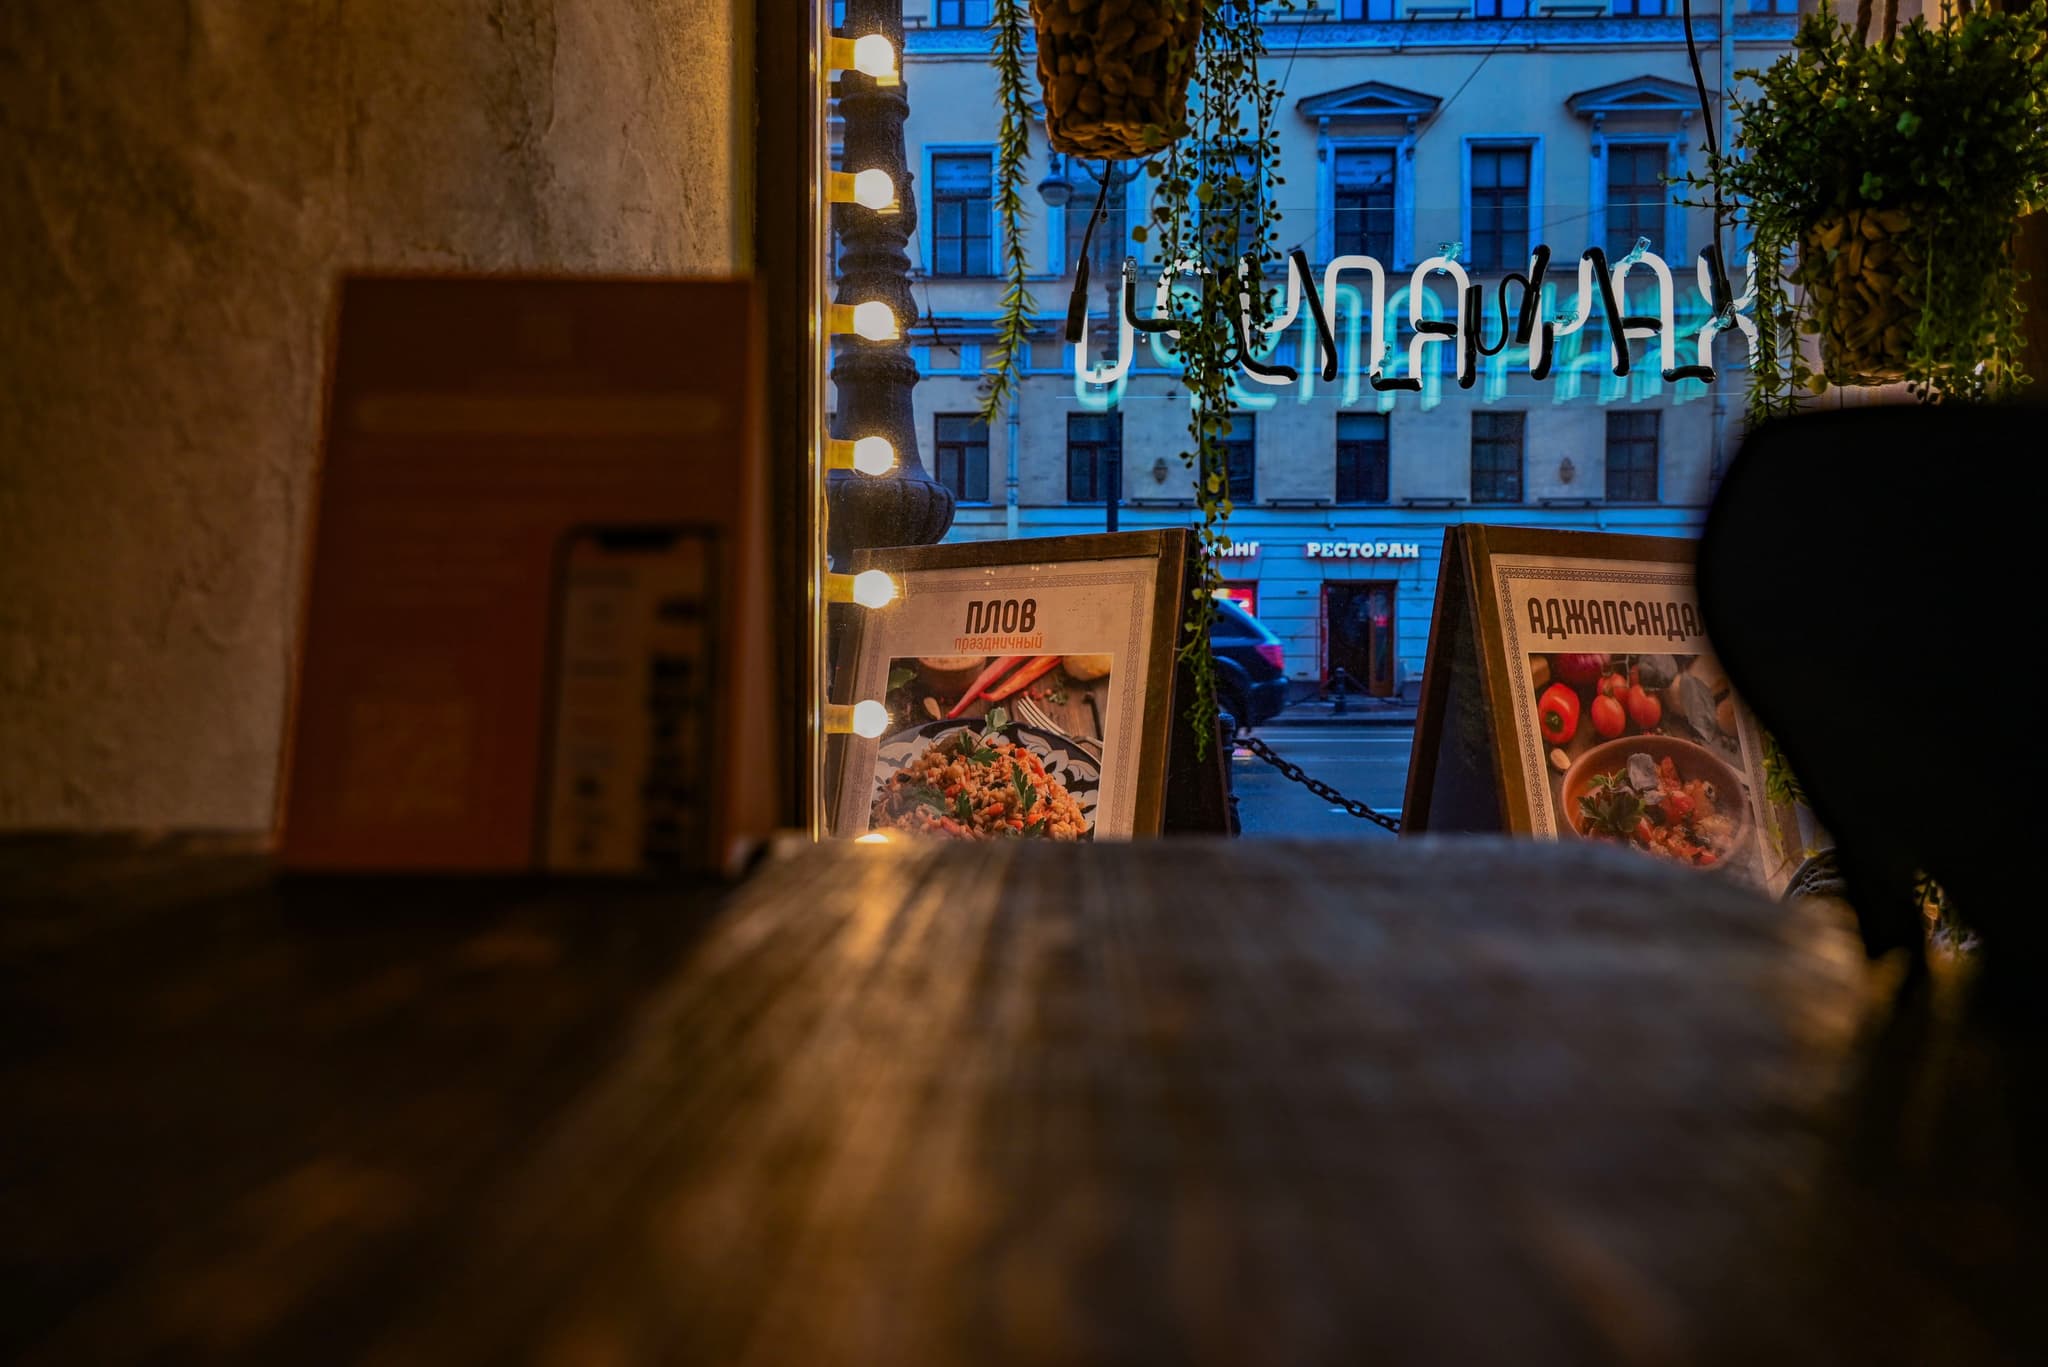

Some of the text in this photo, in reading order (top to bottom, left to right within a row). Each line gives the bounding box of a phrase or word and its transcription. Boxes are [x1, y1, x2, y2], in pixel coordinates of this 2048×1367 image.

[1307, 542, 1419, 558] РЕСТОРАН
[965, 598, 1037, 634] ПЛОВ
[1527, 597, 1705, 641] АДЖАПСАНДА
[954, 632, 1044, 654] праздничный
